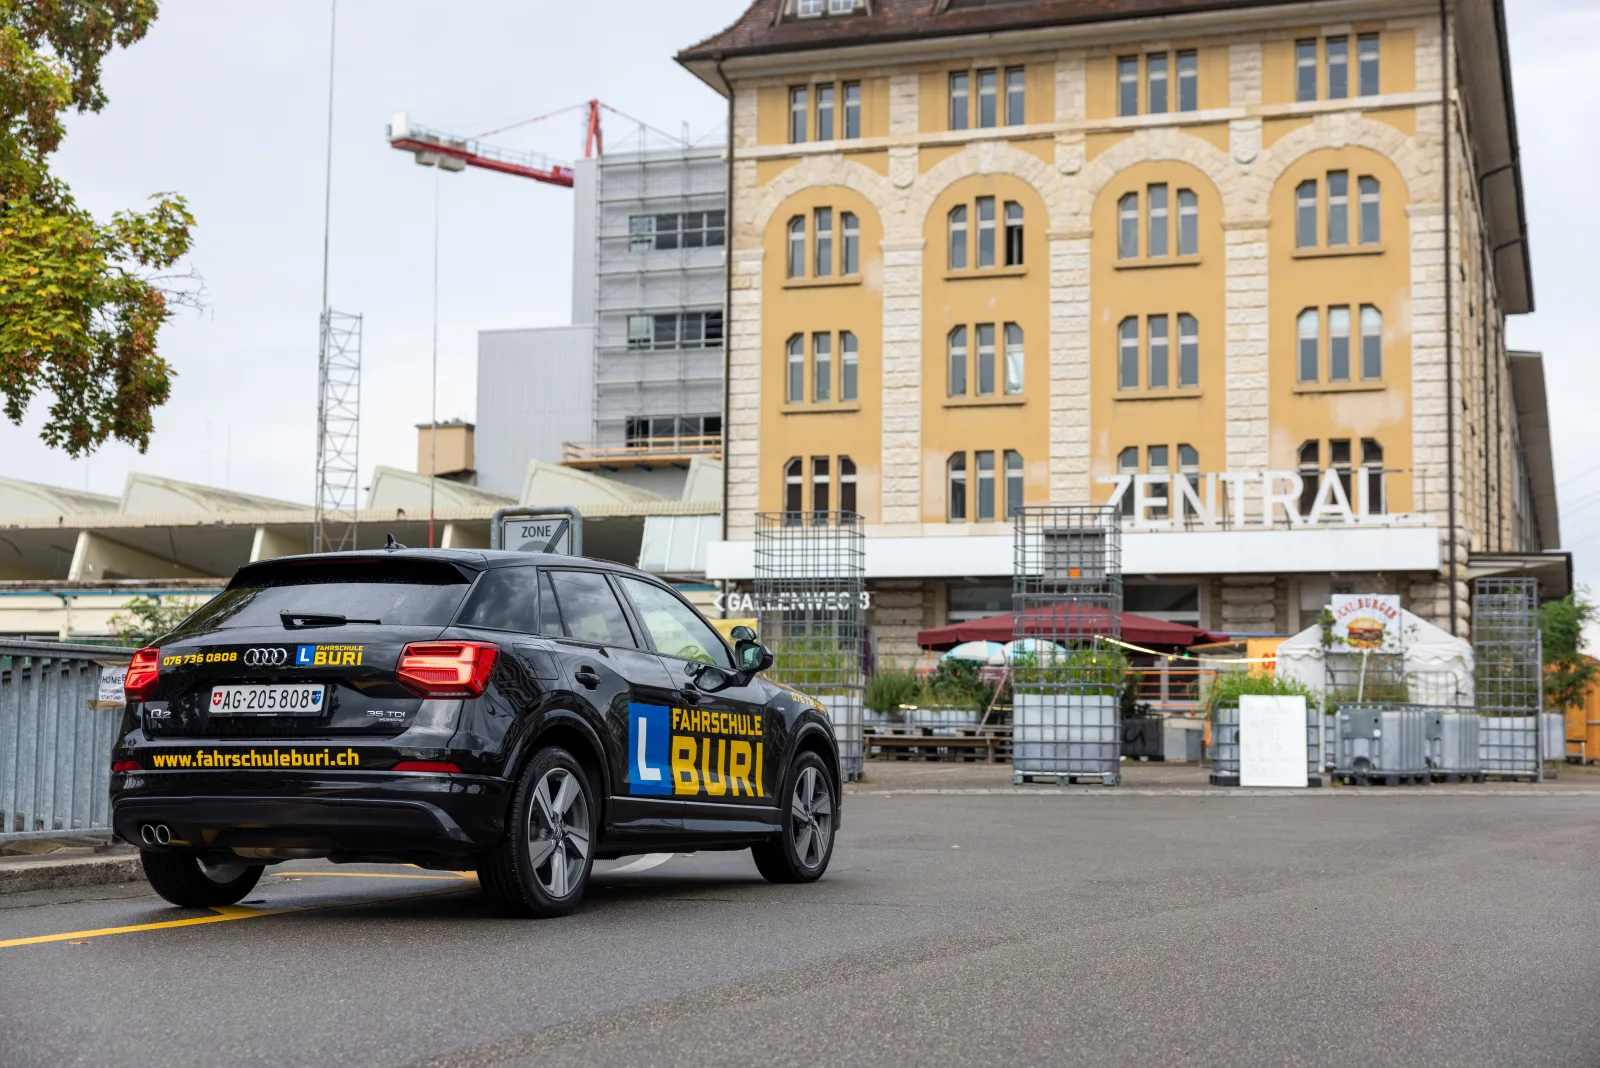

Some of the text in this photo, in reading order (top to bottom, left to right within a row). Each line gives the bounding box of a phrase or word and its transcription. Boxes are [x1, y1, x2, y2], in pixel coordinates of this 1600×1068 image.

[521, 525, 551, 538] ZONE
[1357, 598, 1398, 620] BURGER
[163, 652, 238, 666] 076 736 0808
[314, 651, 363, 666] BURI
[150, 709, 172, 719] Q2
[386, 710, 405, 718] TDI
[672, 708, 763, 736] FAHRSCHULE
[153, 748, 359, 768] www.fahrschuleburi.ch
[672, 735, 764, 798] BURI
